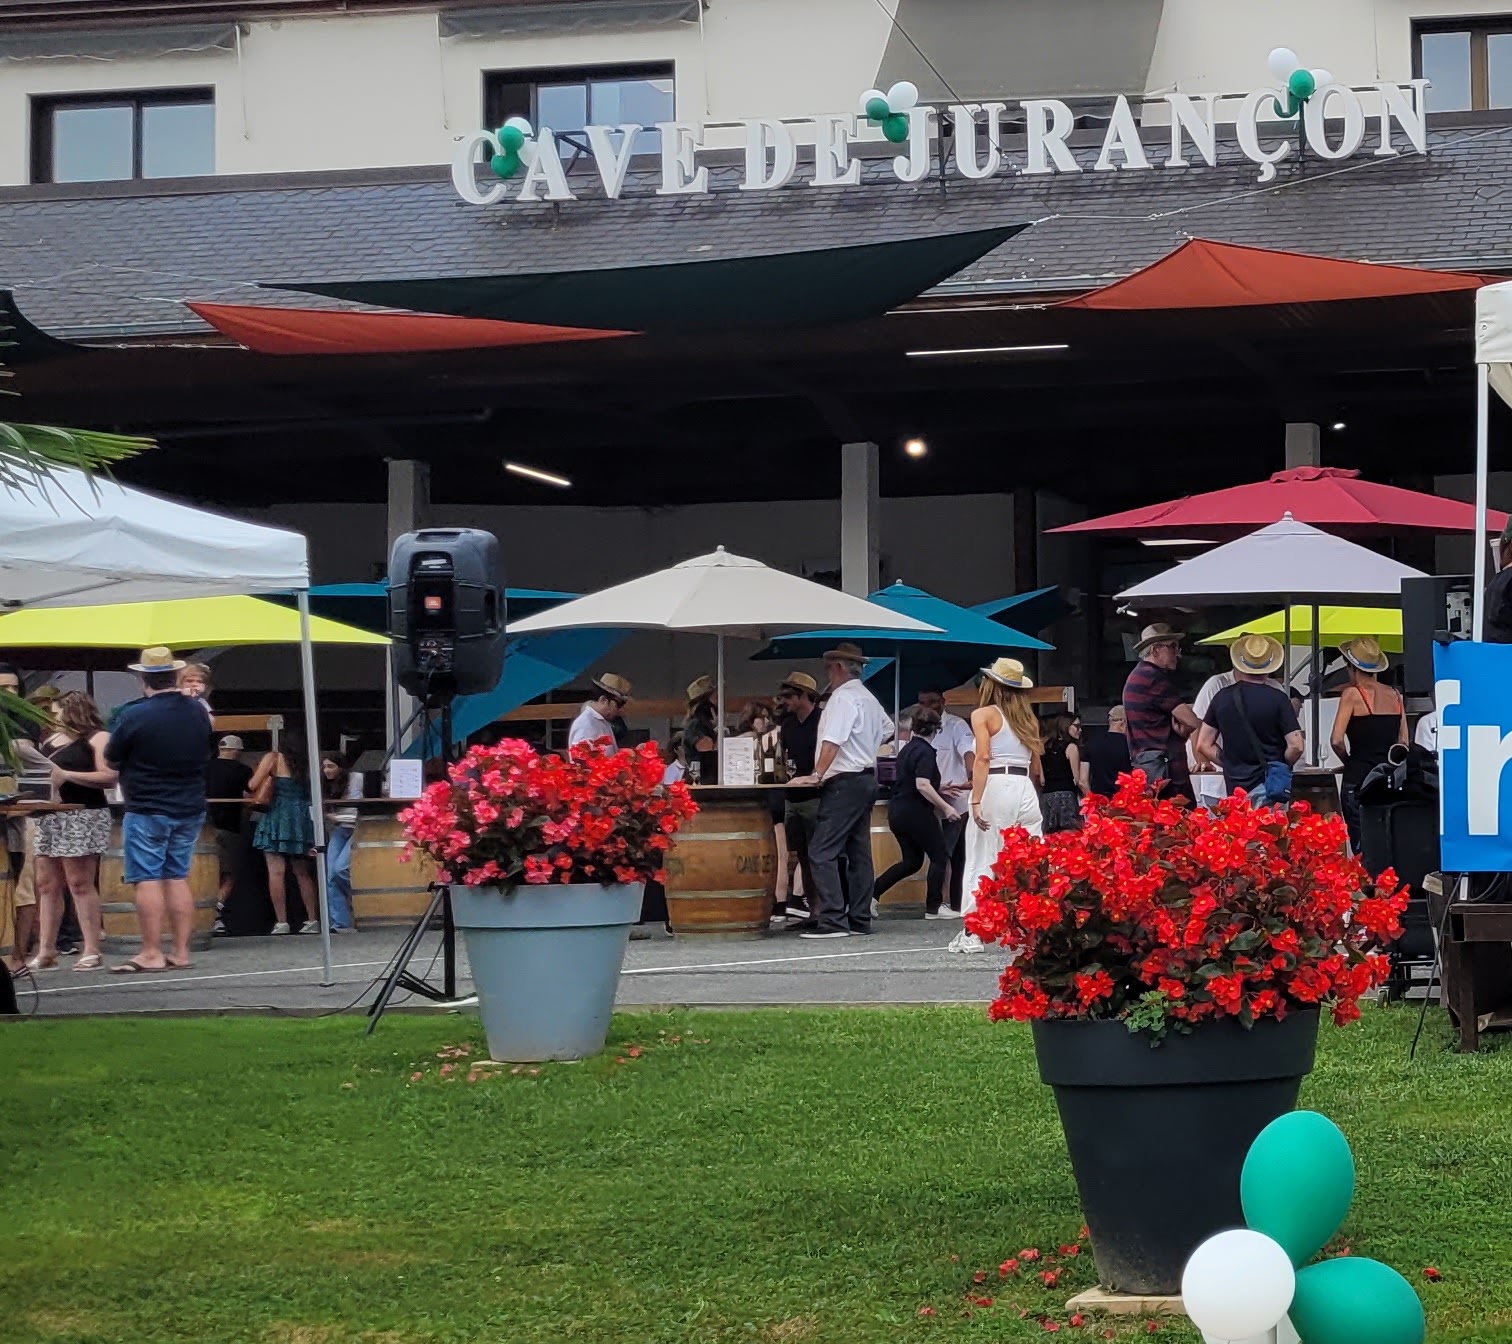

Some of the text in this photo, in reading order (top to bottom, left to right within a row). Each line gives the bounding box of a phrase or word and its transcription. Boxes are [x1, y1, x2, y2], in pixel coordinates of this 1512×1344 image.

[451, 77, 1433, 205] CAVE DE JURANÇON
